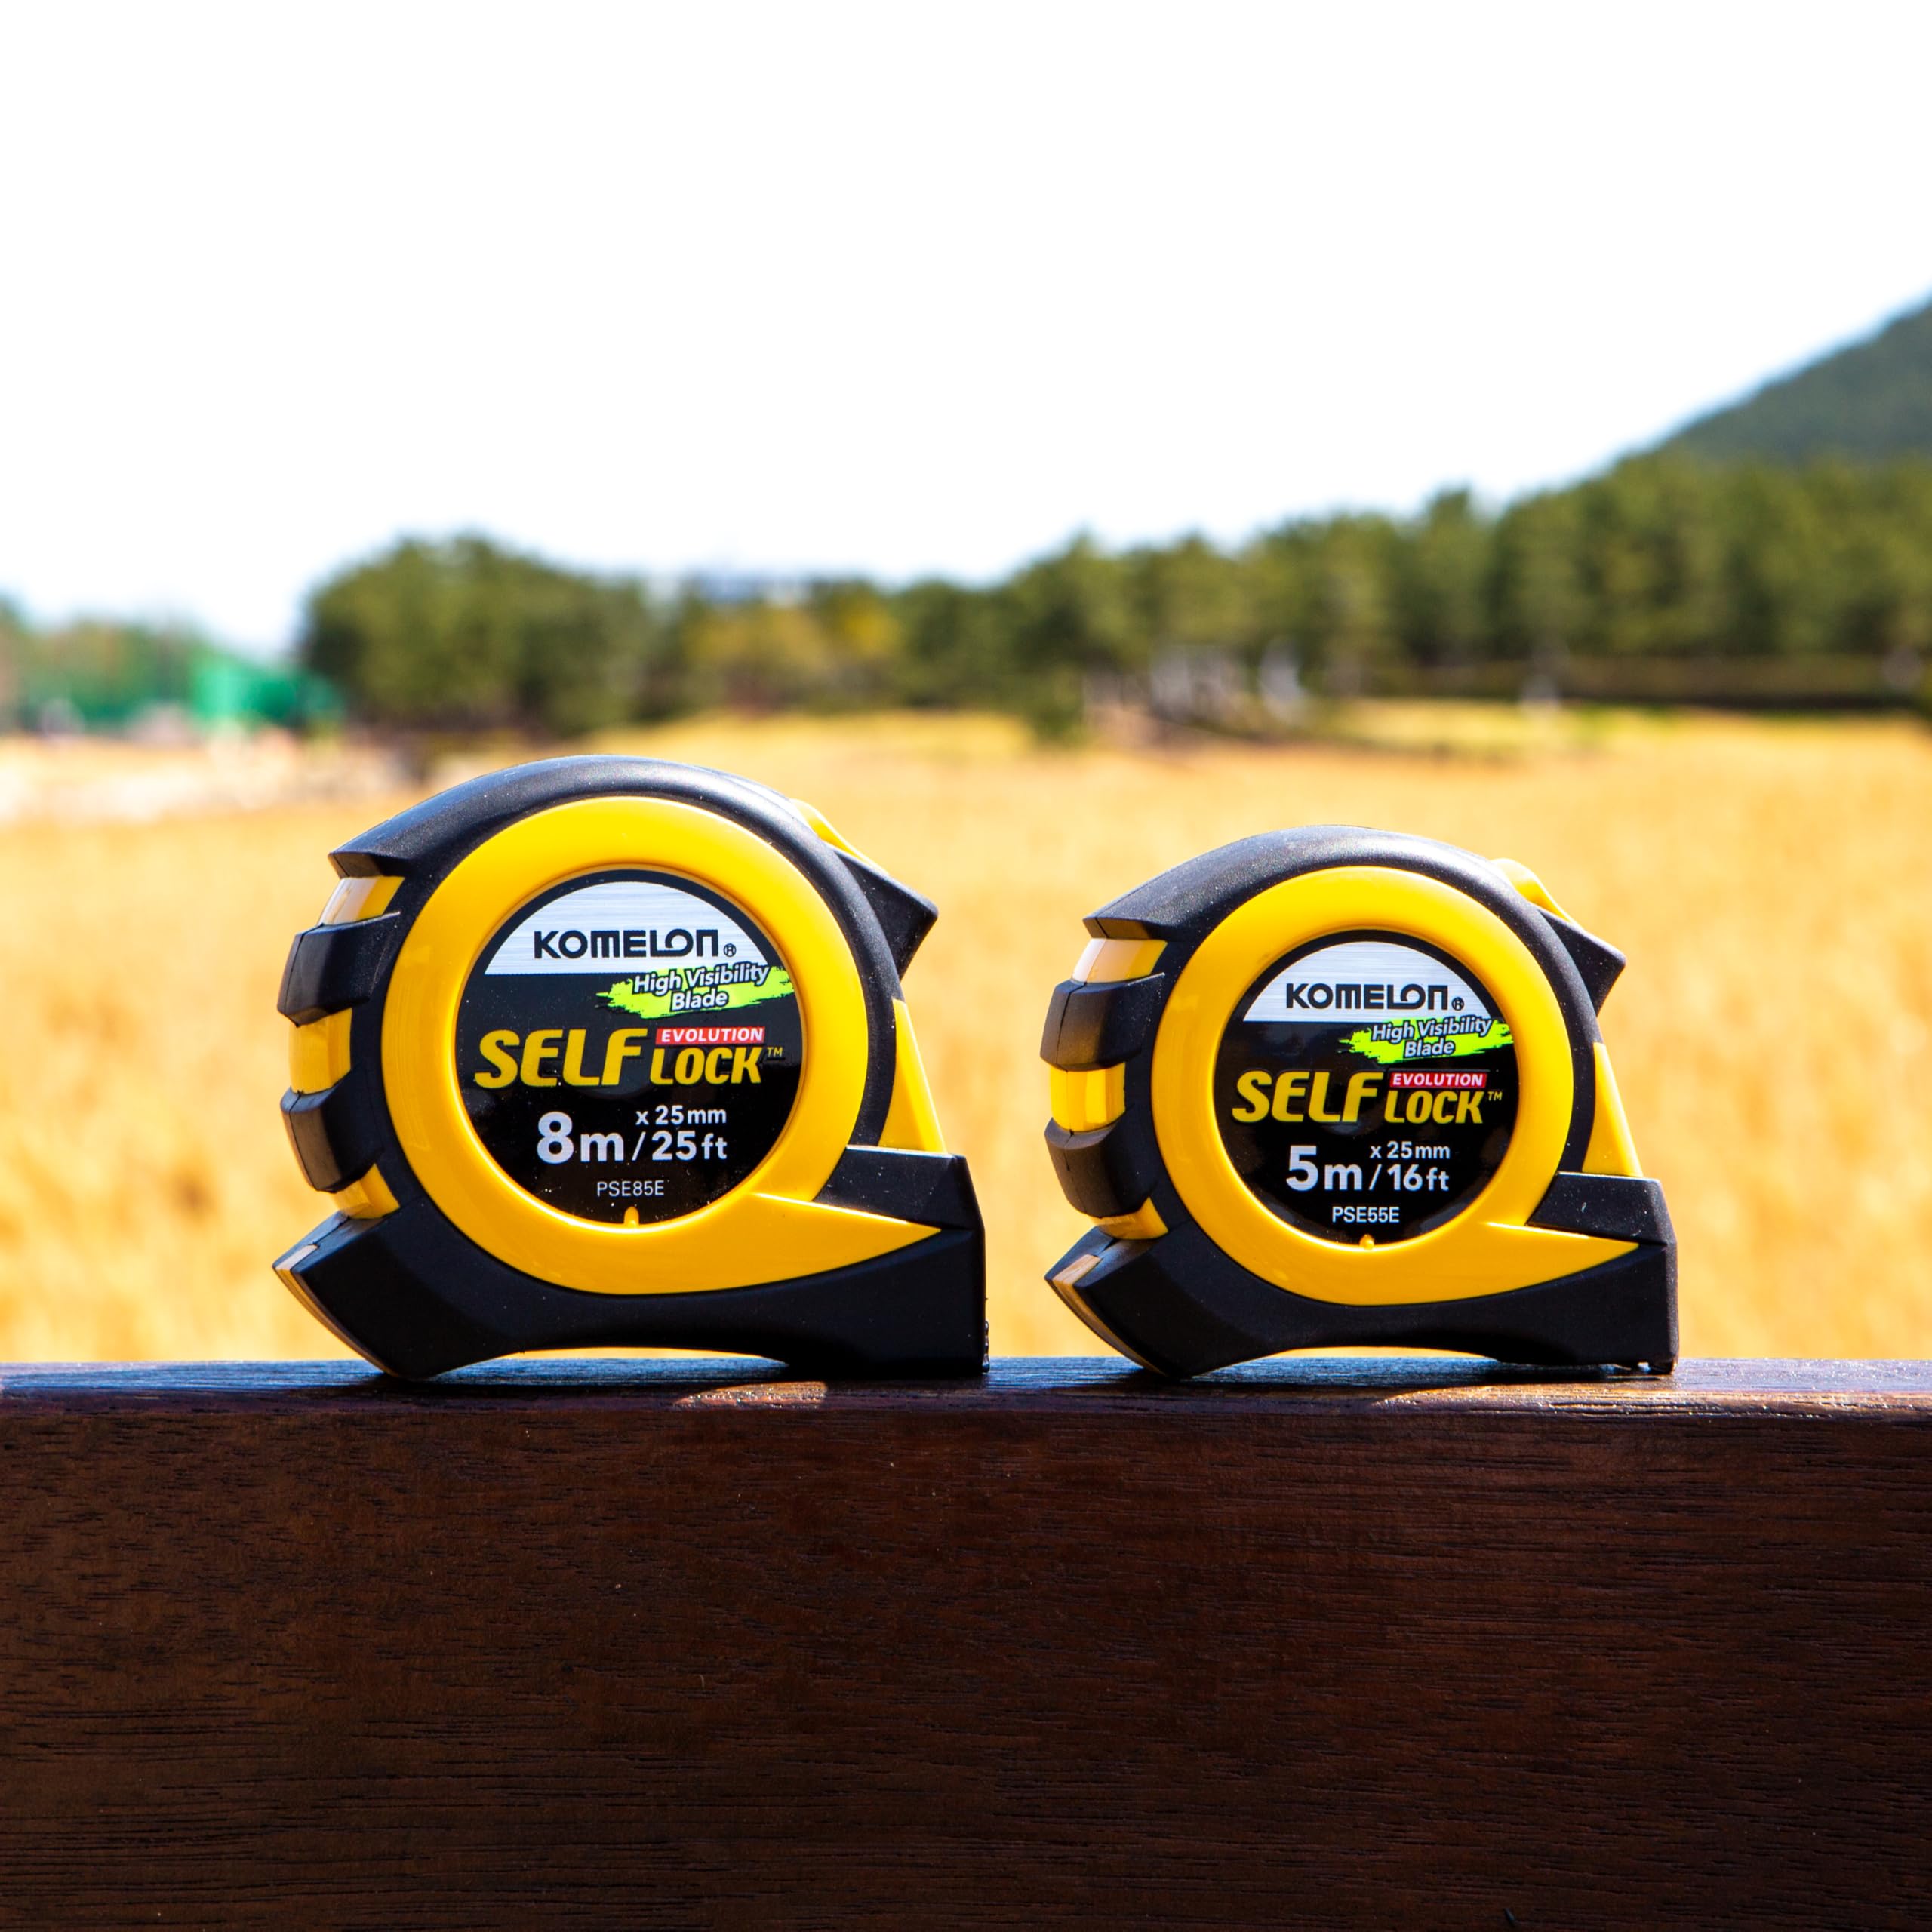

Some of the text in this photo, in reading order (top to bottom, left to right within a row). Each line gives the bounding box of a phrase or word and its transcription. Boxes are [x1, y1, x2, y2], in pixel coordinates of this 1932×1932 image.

[632, 963, 770, 996] High Visibility
[671, 992, 728, 1012] Blade
[660, 1027, 765, 1044] EVOLUTION
[1372, 1017, 1493, 1044] High Visibility
[1404, 1038, 1455, 1057] Blade
[474, 1028, 648, 1089] SELF
[1392, 1072, 1484, 1087] EVOLUTION
[1232, 1070, 1384, 1123] SELF
[635, 1106, 728, 1126] x 25mm
[1369, 1141, 1451, 1160] x 25mm
[596, 1180, 665, 1197] PSE85E
[1331, 1207, 1400, 1223] PSE55E
